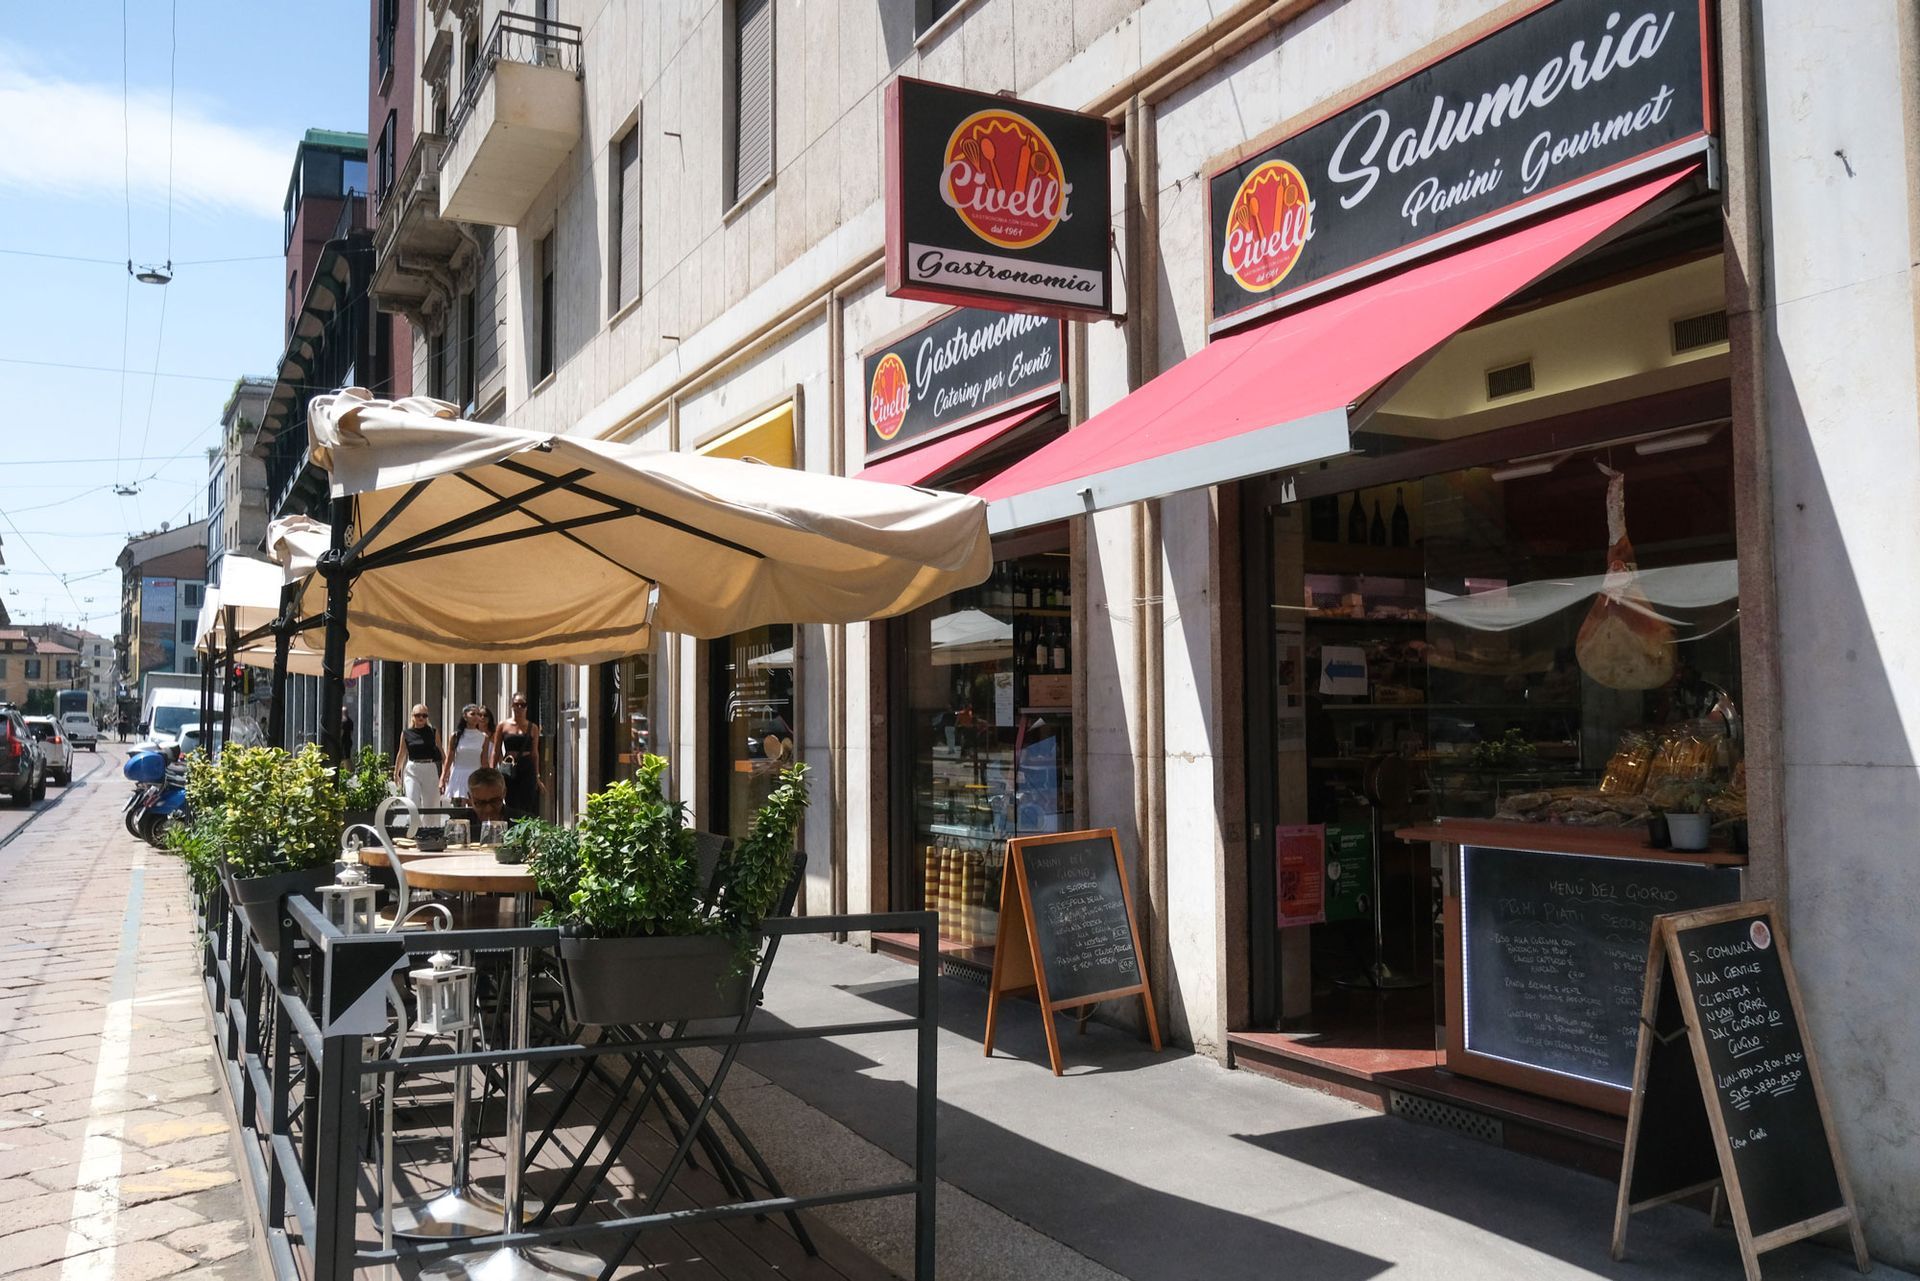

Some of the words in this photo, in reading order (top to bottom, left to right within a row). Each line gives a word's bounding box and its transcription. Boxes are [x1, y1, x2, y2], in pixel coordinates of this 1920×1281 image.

[1327, 11, 1675, 209] Salumeria
[1402, 158, 1504, 228] Panini
[1521, 84, 1675, 193] Gourmet
[939, 160, 1073, 222] Civelli
[1222, 198, 1316, 275] Civelli
[917, 250, 1096, 293] Gastronomia
[870, 382, 911, 426] Civelli
[933, 380, 982, 418] Catering
[982, 370, 1006, 397] per
[1008, 346, 1053, 388] Eventi
[1591, 883, 1619, 898] DEL
[1706, 940, 1755, 959] COMUNICA
[1695, 971, 1721, 987] ALLA
[1767, 1010, 1780, 1022] 10
